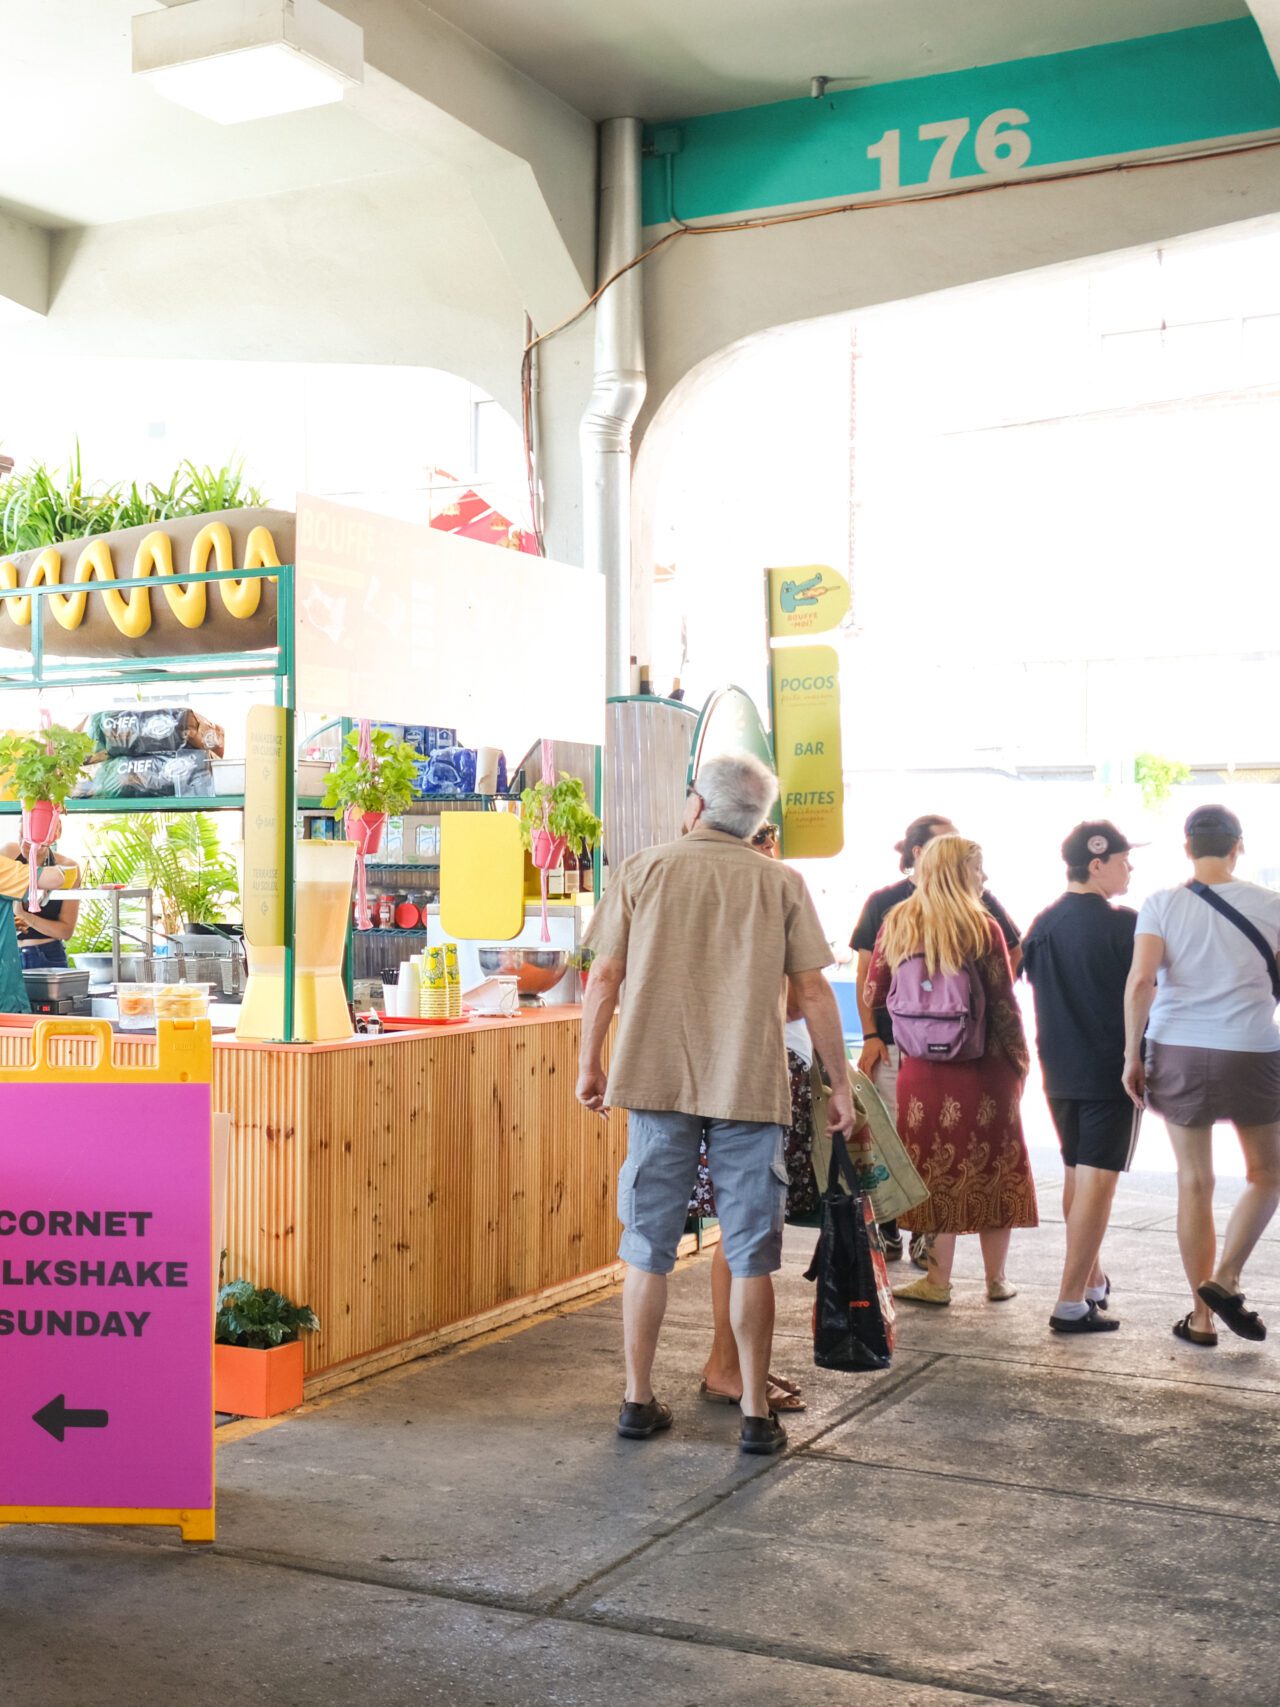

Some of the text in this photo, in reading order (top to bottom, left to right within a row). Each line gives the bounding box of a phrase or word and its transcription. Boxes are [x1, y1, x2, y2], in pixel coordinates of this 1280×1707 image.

[866, 107, 1032, 191] 176
[787, 612, 817, 621] BOUFFE
[780, 676, 835, 692] POGOS
[102, 716, 136, 729] CHEF
[794, 742, 824, 757] BAR
[117, 759, 152, 775] CHEF
[785, 791, 835, 806] FRITES
